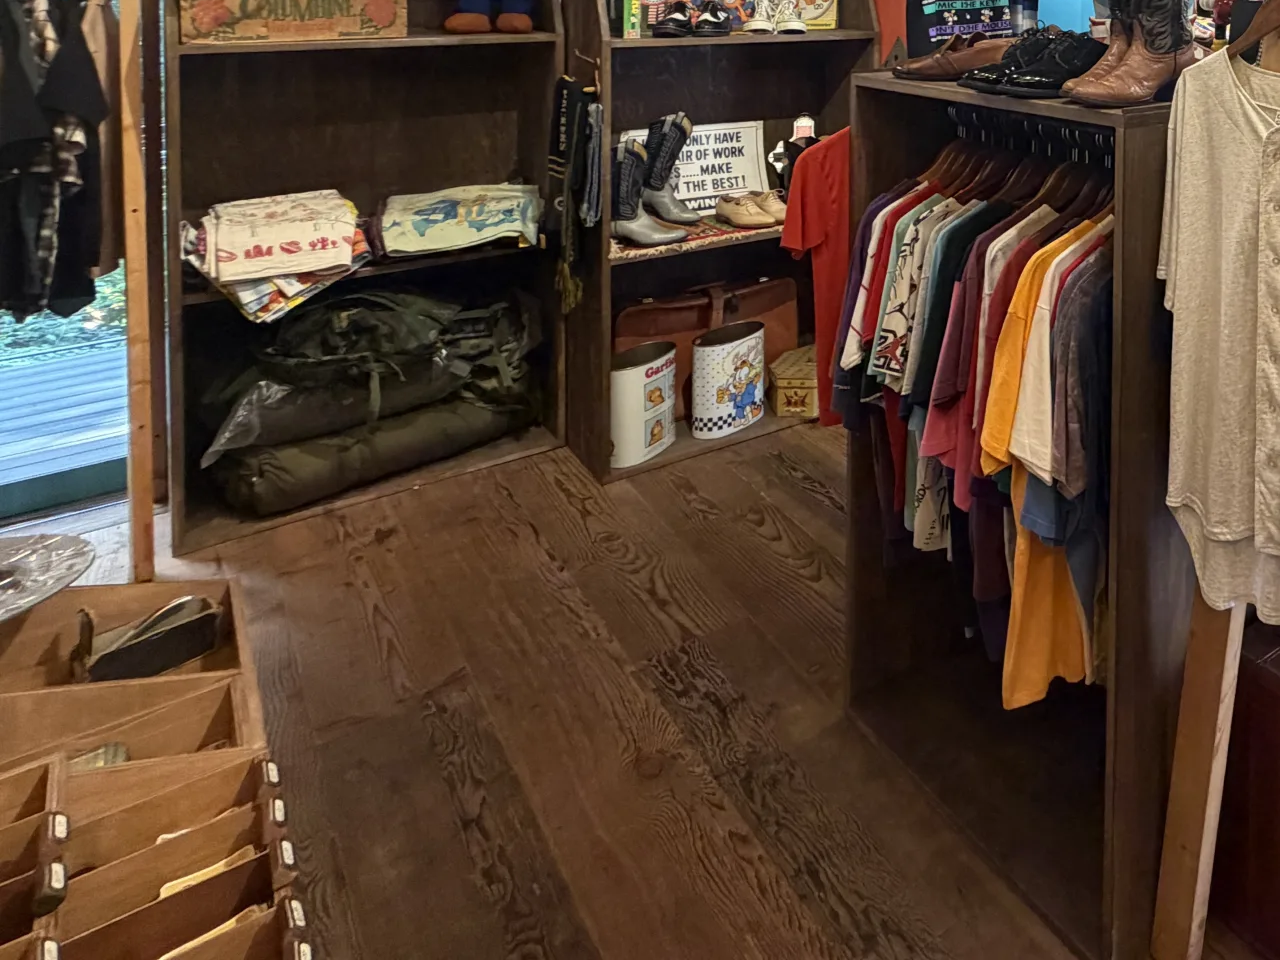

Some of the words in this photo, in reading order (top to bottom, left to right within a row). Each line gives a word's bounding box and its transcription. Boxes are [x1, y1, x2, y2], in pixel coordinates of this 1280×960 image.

[714, 131, 742, 145] HAVE
[695, 148, 710, 161] OF
[713, 146, 745, 159] WORK
[700, 162, 732, 176] MAKE
[683, 178, 708, 194] THE
[712, 175, 747, 190] BEST!
